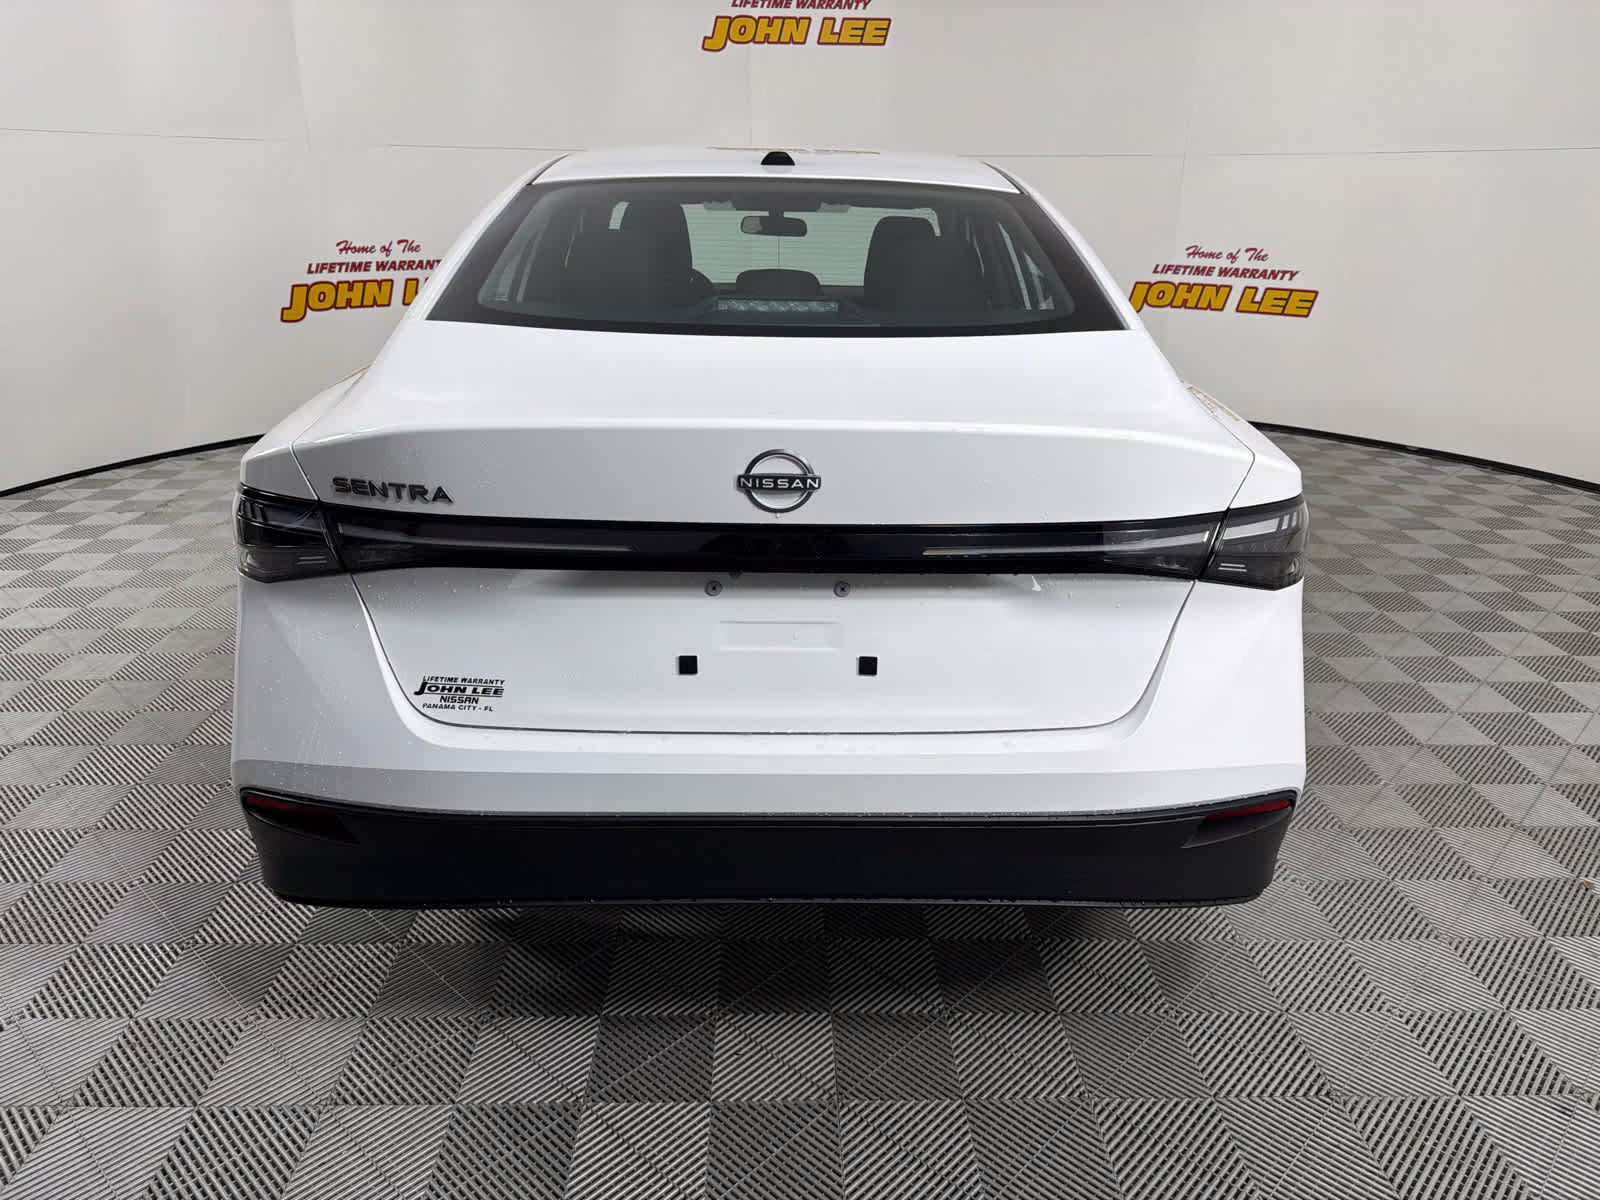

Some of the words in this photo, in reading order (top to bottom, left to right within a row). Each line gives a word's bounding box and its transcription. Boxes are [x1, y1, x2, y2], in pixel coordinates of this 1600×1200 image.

[731, 0, 792, 8] LIFETIME
[796, 0, 871, 9] WARRANTY
[702, 15, 811, 51] JOHN
[817, 17, 891, 45] LEE
[336, 240, 376, 254] Home
[380, 241, 393, 257] of
[397, 239, 422, 253] The
[1185, 245, 1223, 259] Home
[1226, 249, 1241, 263] of
[1245, 247, 1269, 262] The
[307, 262, 372, 274] LIFETIME
[375, 259, 442, 272] WARRANT
[1152, 264, 1215, 277] LIFETIME
[1217, 267, 1299, 281] WARRANTY
[280, 279, 394, 323] JOHN
[1236, 286, 1319, 318] LEE
[332, 477, 453, 504] SENTRA
[740, 478, 819, 488] NISSAN
[413, 681, 468, 696] JOHN
[471, 687, 505, 696] LEE
[460, 677, 505, 685] WARRANTY
[422, 702, 456, 710] PANAMA
[439, 696, 479, 704] NISSAN
